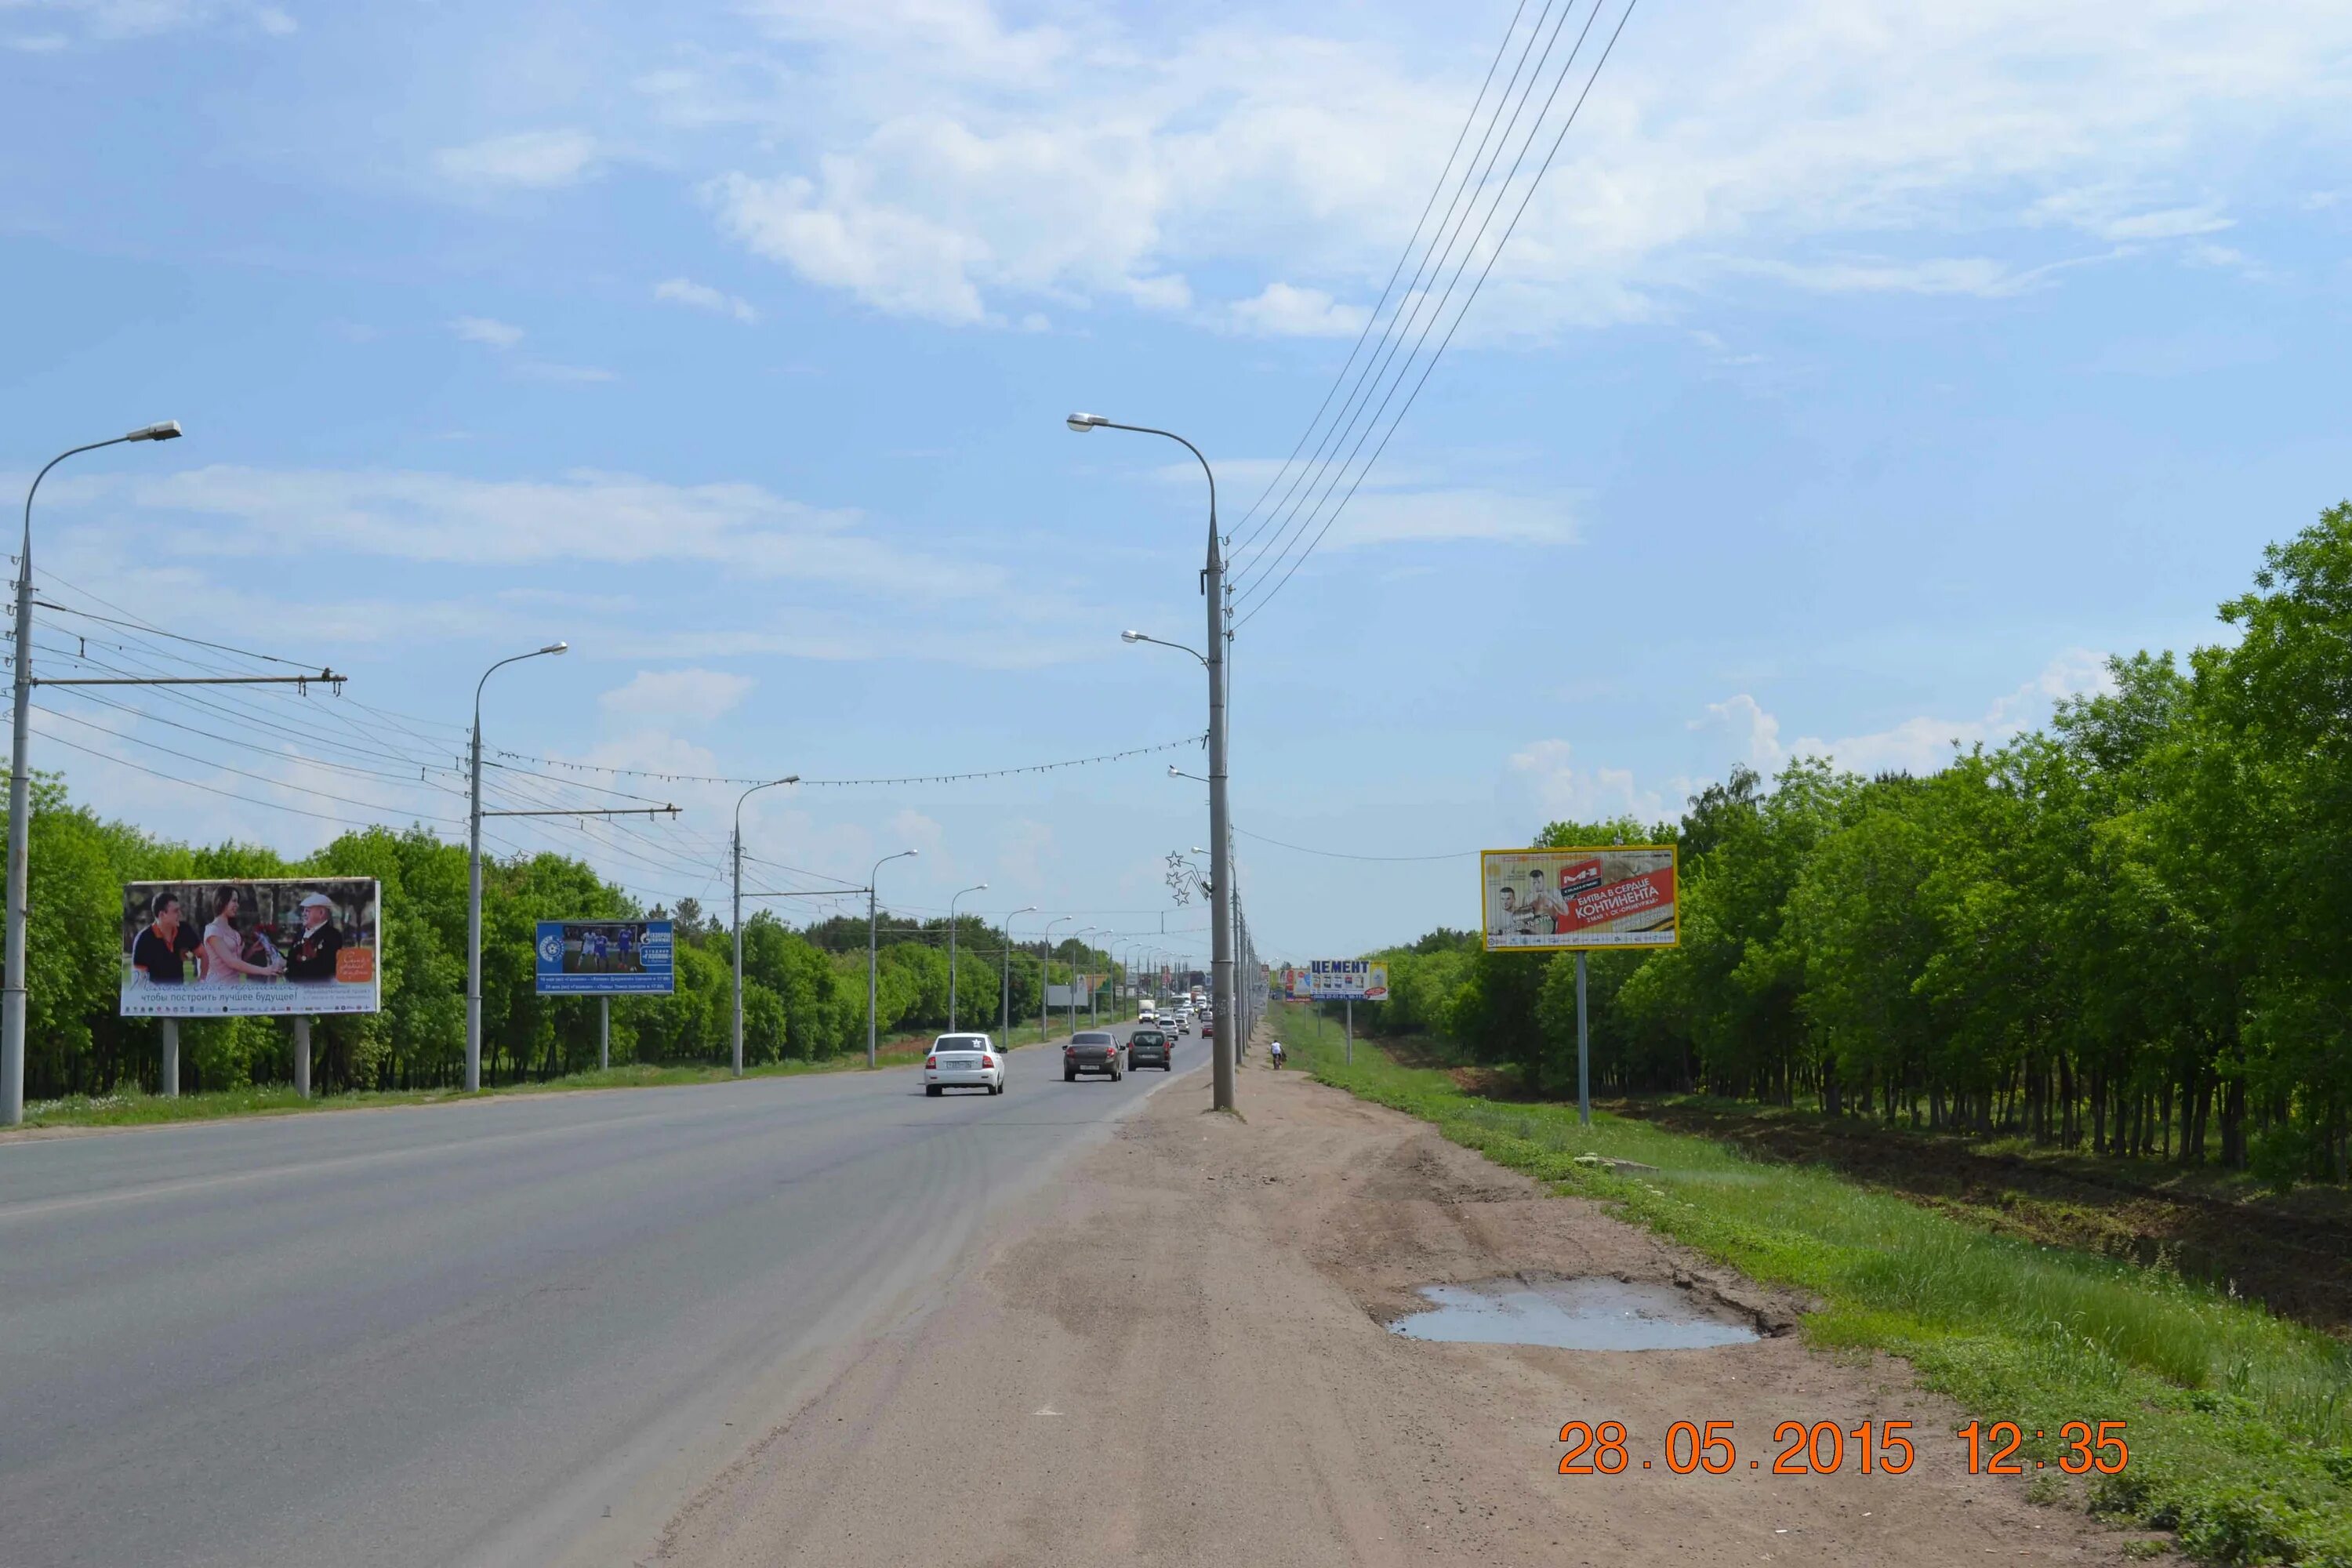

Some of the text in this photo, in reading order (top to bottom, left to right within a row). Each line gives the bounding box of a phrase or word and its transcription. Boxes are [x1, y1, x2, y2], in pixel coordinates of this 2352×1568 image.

[1575, 886, 1659, 918] КОНТИНЕНТА
[1577, 892, 1607, 906] БИТВА
[1607, 888, 1614, 897] В
[1615, 878, 1650, 895] СЕРДЦЕ
[1312, 960, 1369, 975] ЦЕМЕНТ
[141, 992, 169, 1001] чтобы
[171, 994, 217, 1003] построить
[220, 993, 253, 1002] лучшее
[256, 992, 298, 1003] будущее!
